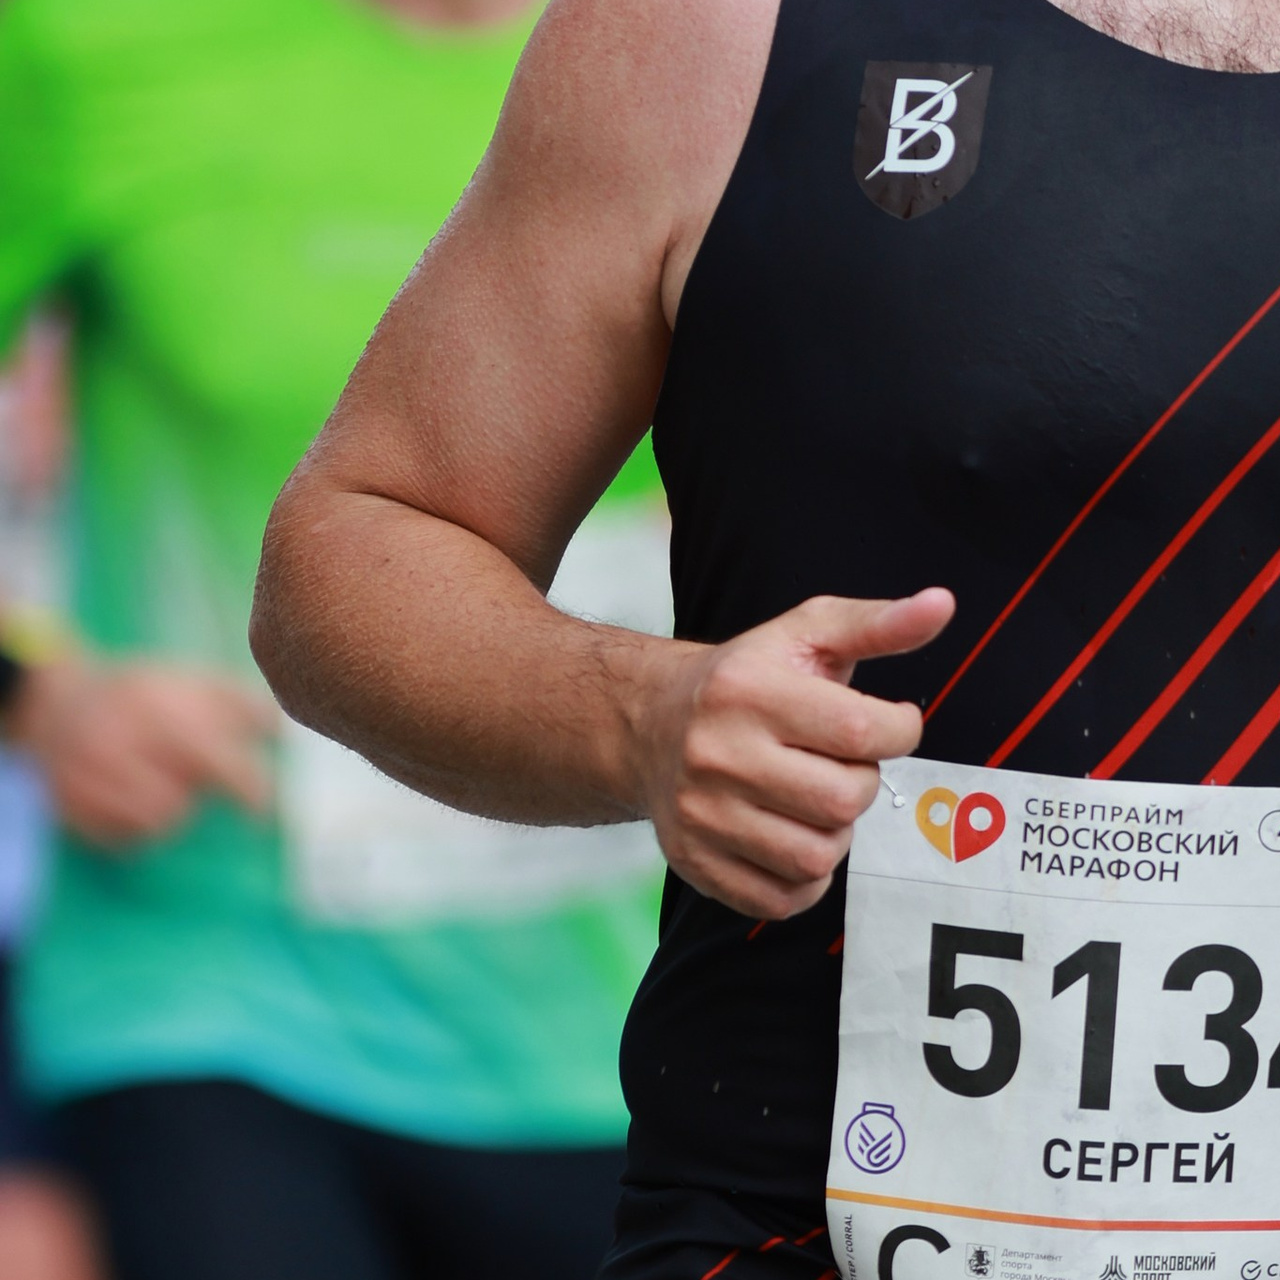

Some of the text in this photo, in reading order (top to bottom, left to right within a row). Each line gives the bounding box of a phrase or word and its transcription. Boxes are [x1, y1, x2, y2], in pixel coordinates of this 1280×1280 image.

[1024, 797, 1184, 826] СБЕРПРАЙМ
[1022, 822, 1239, 855] МОСКОВСКИЙ
[1020, 850, 1180, 882] МАРАФОН
[1042, 1132, 1236, 1184] СЕРГЕЙ
[844, 1213, 854, 1253] CORRAL
[1000, 1260, 1033, 1271] спорта
[1001, 1248, 1064, 1262] Департамент
[1133, 1252, 1217, 1271] МОСКОВСКИЙ
